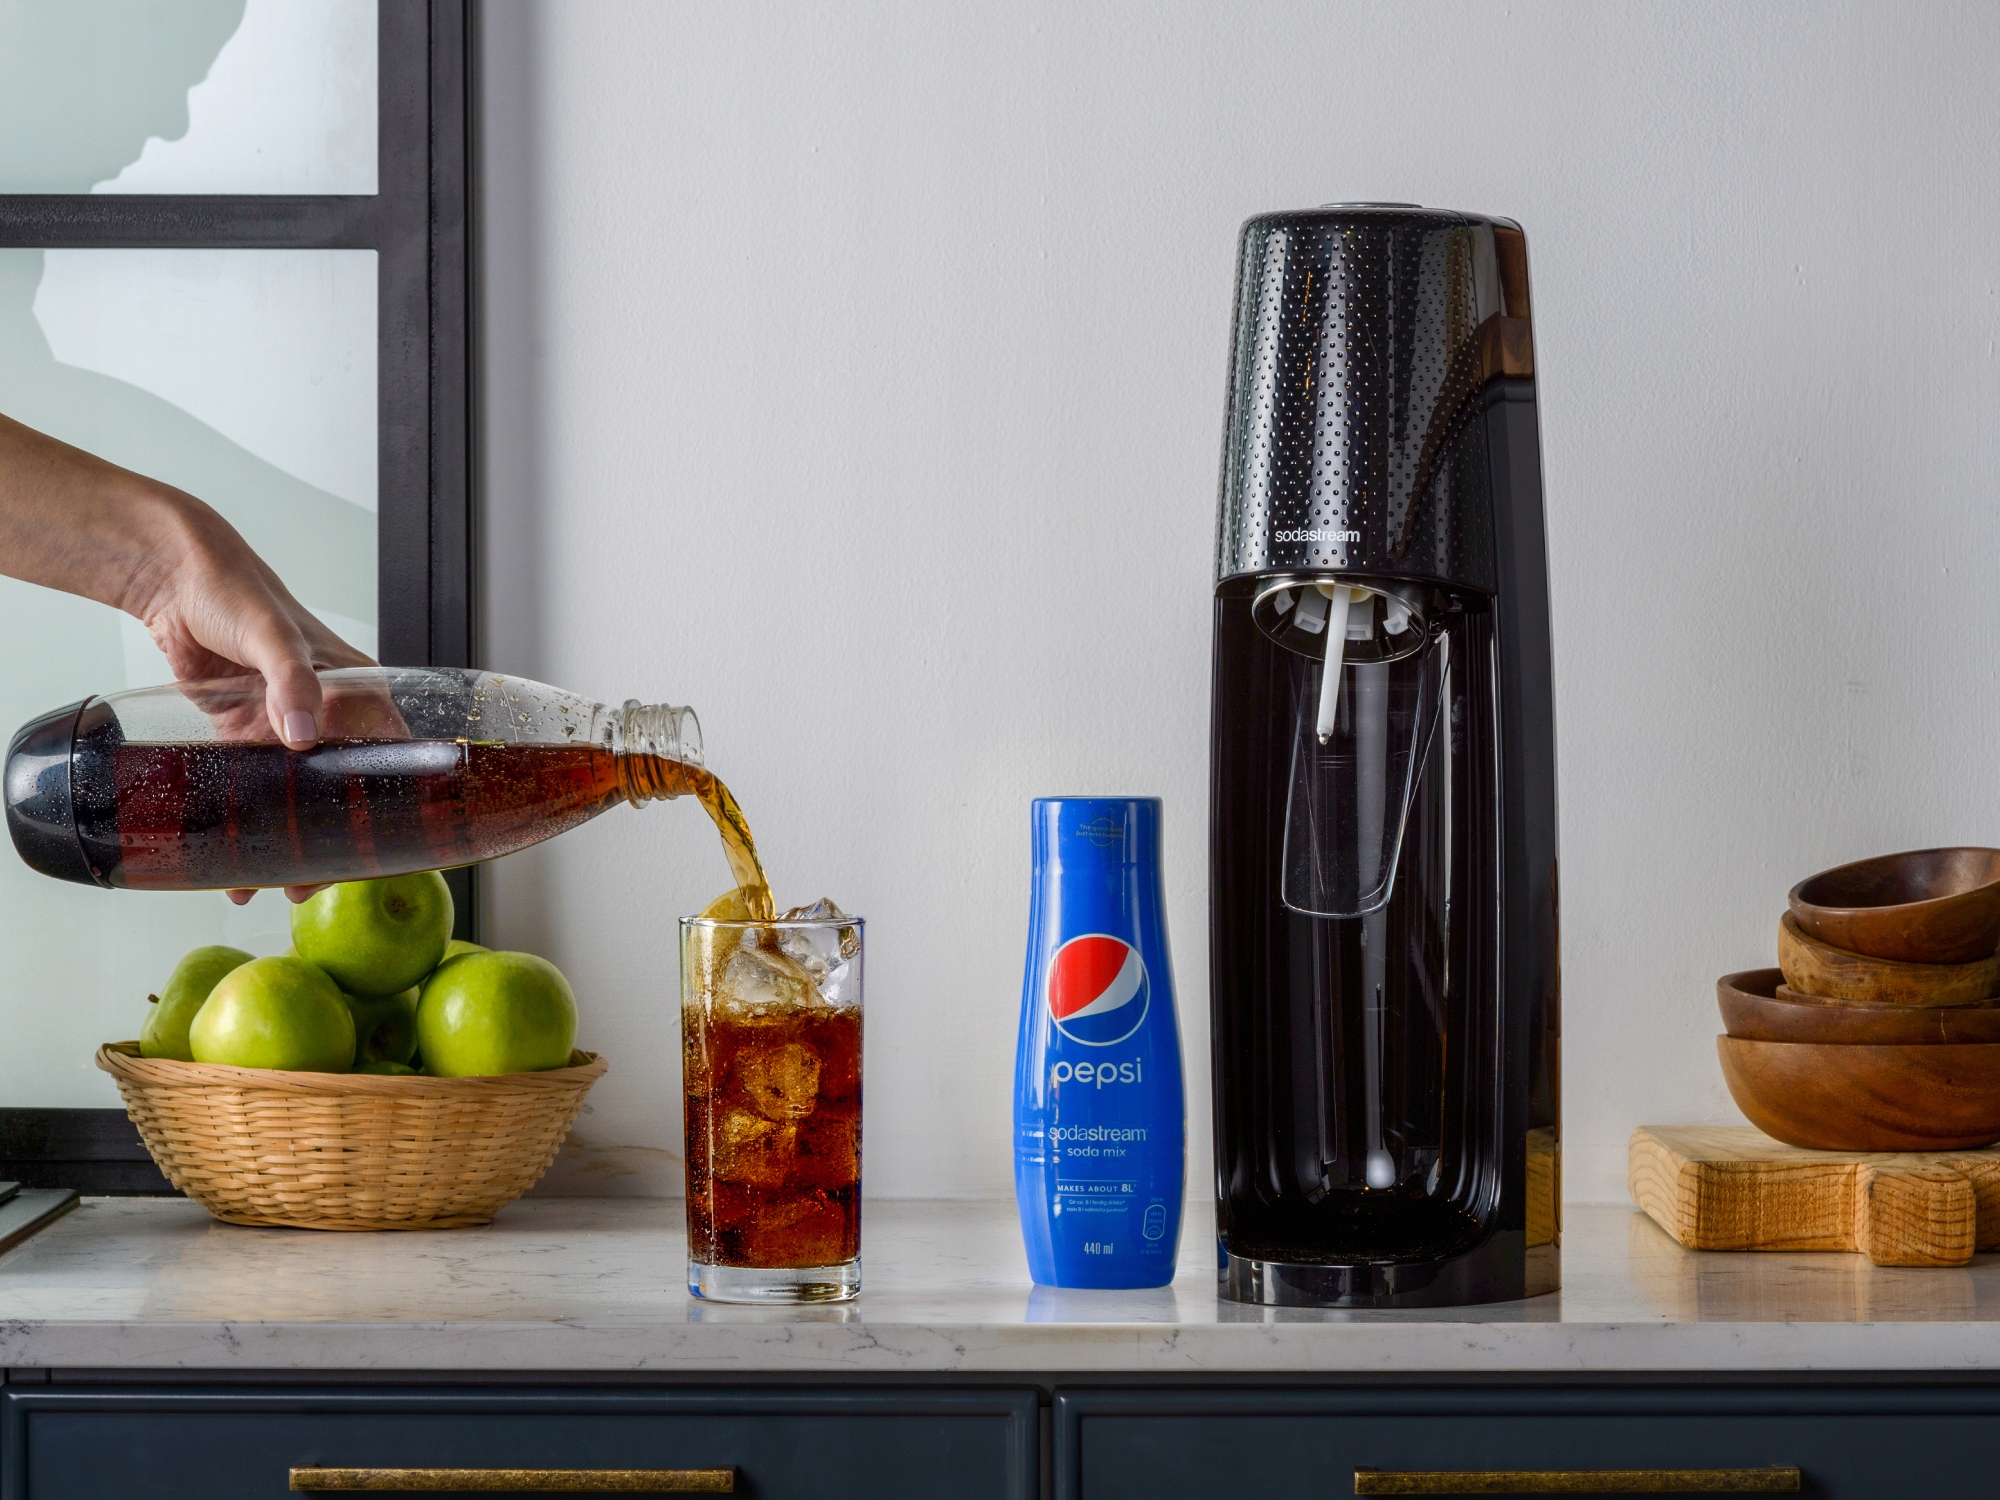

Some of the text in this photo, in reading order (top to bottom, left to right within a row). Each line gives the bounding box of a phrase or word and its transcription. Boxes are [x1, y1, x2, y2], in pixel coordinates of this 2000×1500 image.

[1275, 527, 1361, 543] sodastream
[1052, 1057, 1142, 1090] pepsi
[1049, 1124, 1147, 1142] sodastream
[1067, 1145, 1126, 1157] soda mix
[1057, 1184, 1085, 1192] MAKES
[1083, 1242, 1114, 1255] 440 ml
